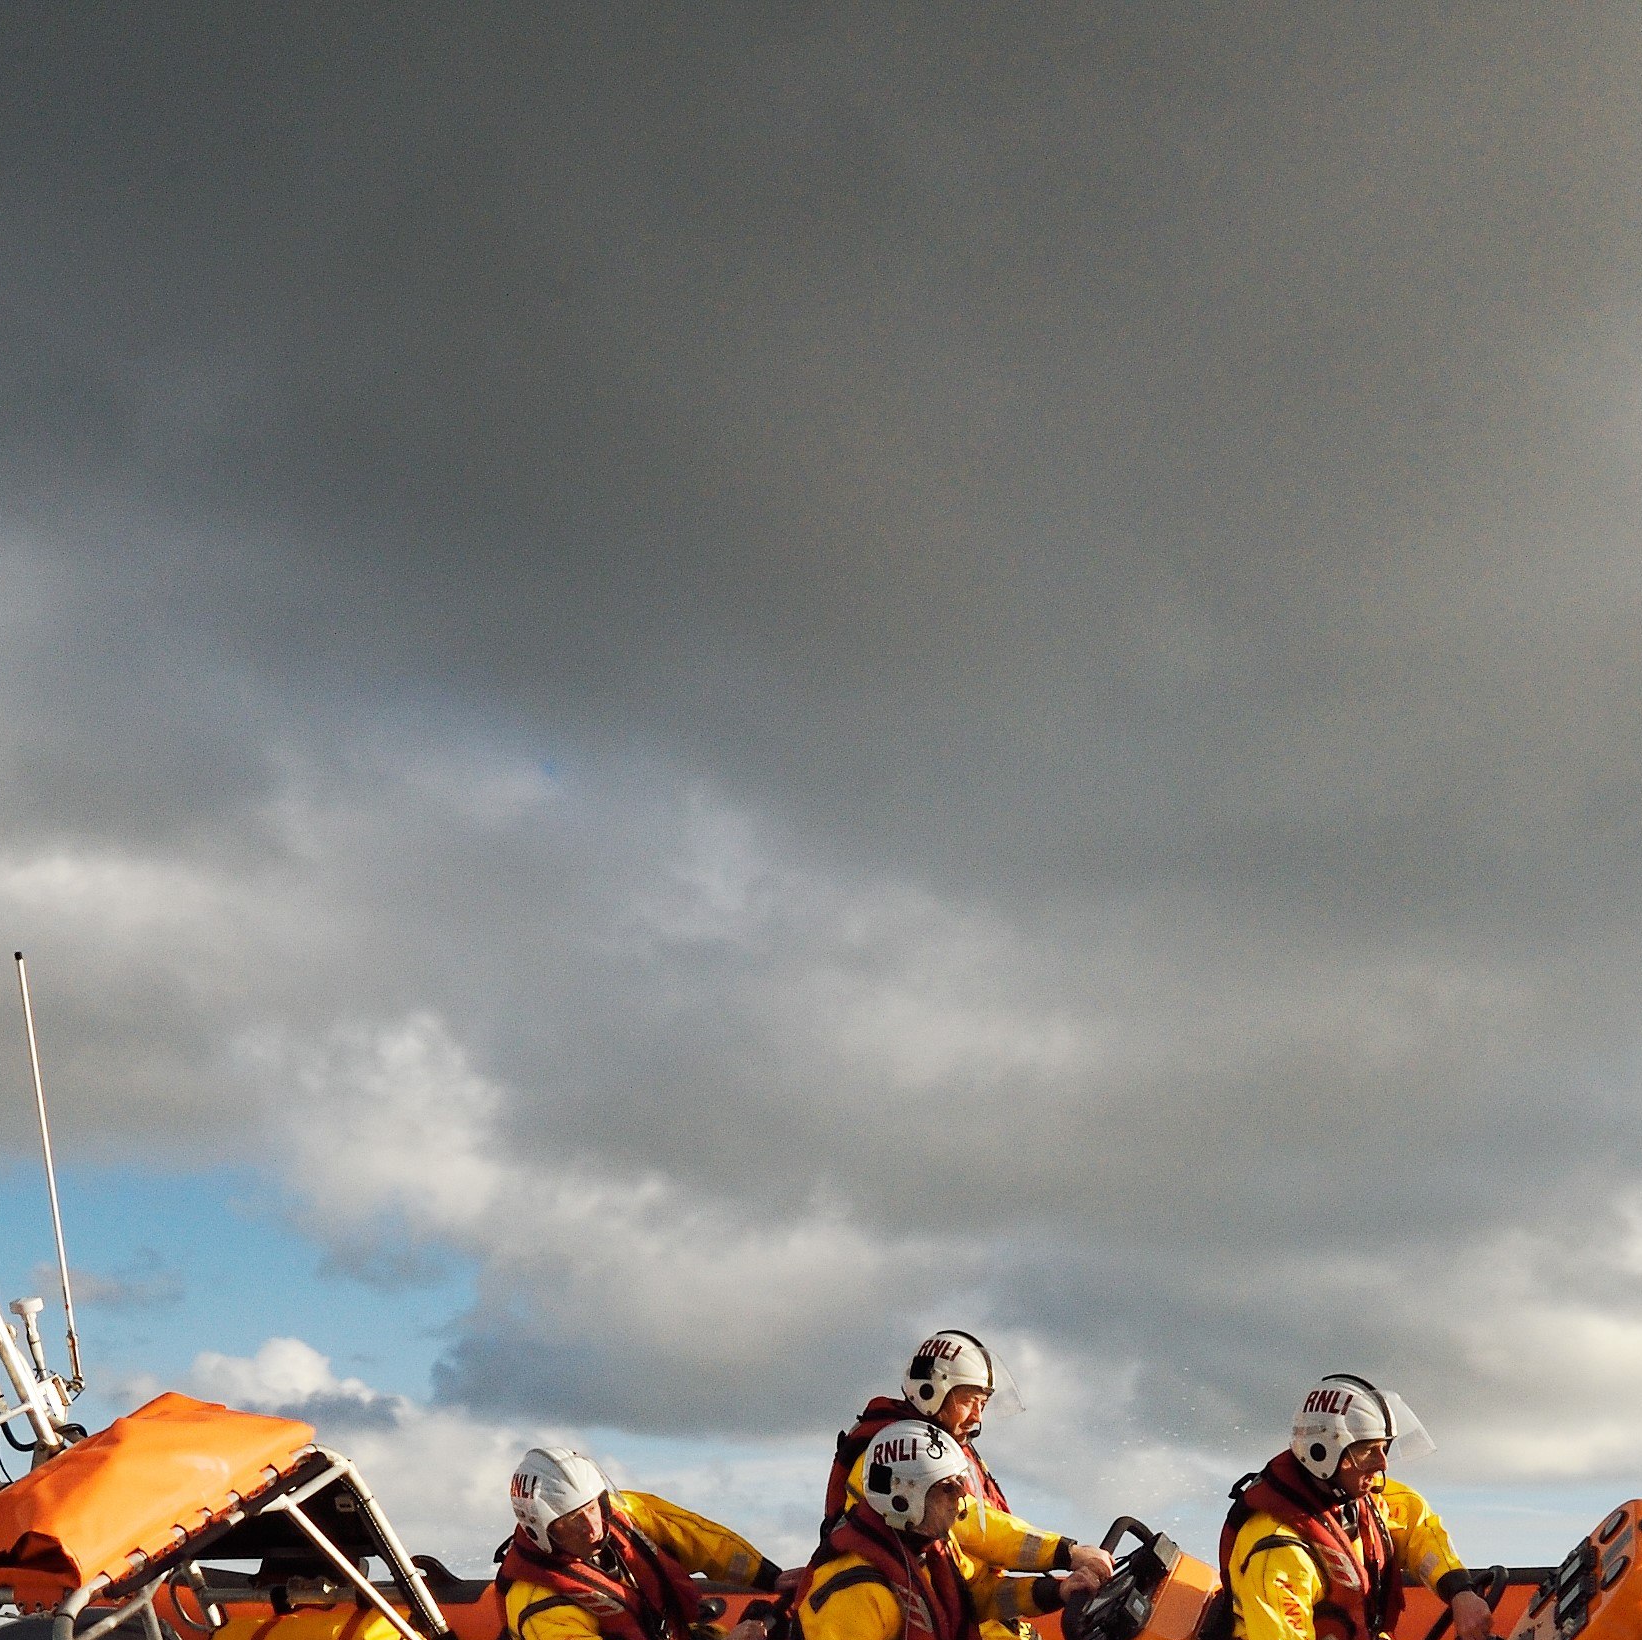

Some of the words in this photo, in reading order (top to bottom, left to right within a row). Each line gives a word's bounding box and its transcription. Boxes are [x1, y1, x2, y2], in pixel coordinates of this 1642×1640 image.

[917, 1339, 963, 1362] RNLI
[1302, 1389, 1354, 1416] RNLI
[872, 1438, 917, 1465] RNLI
